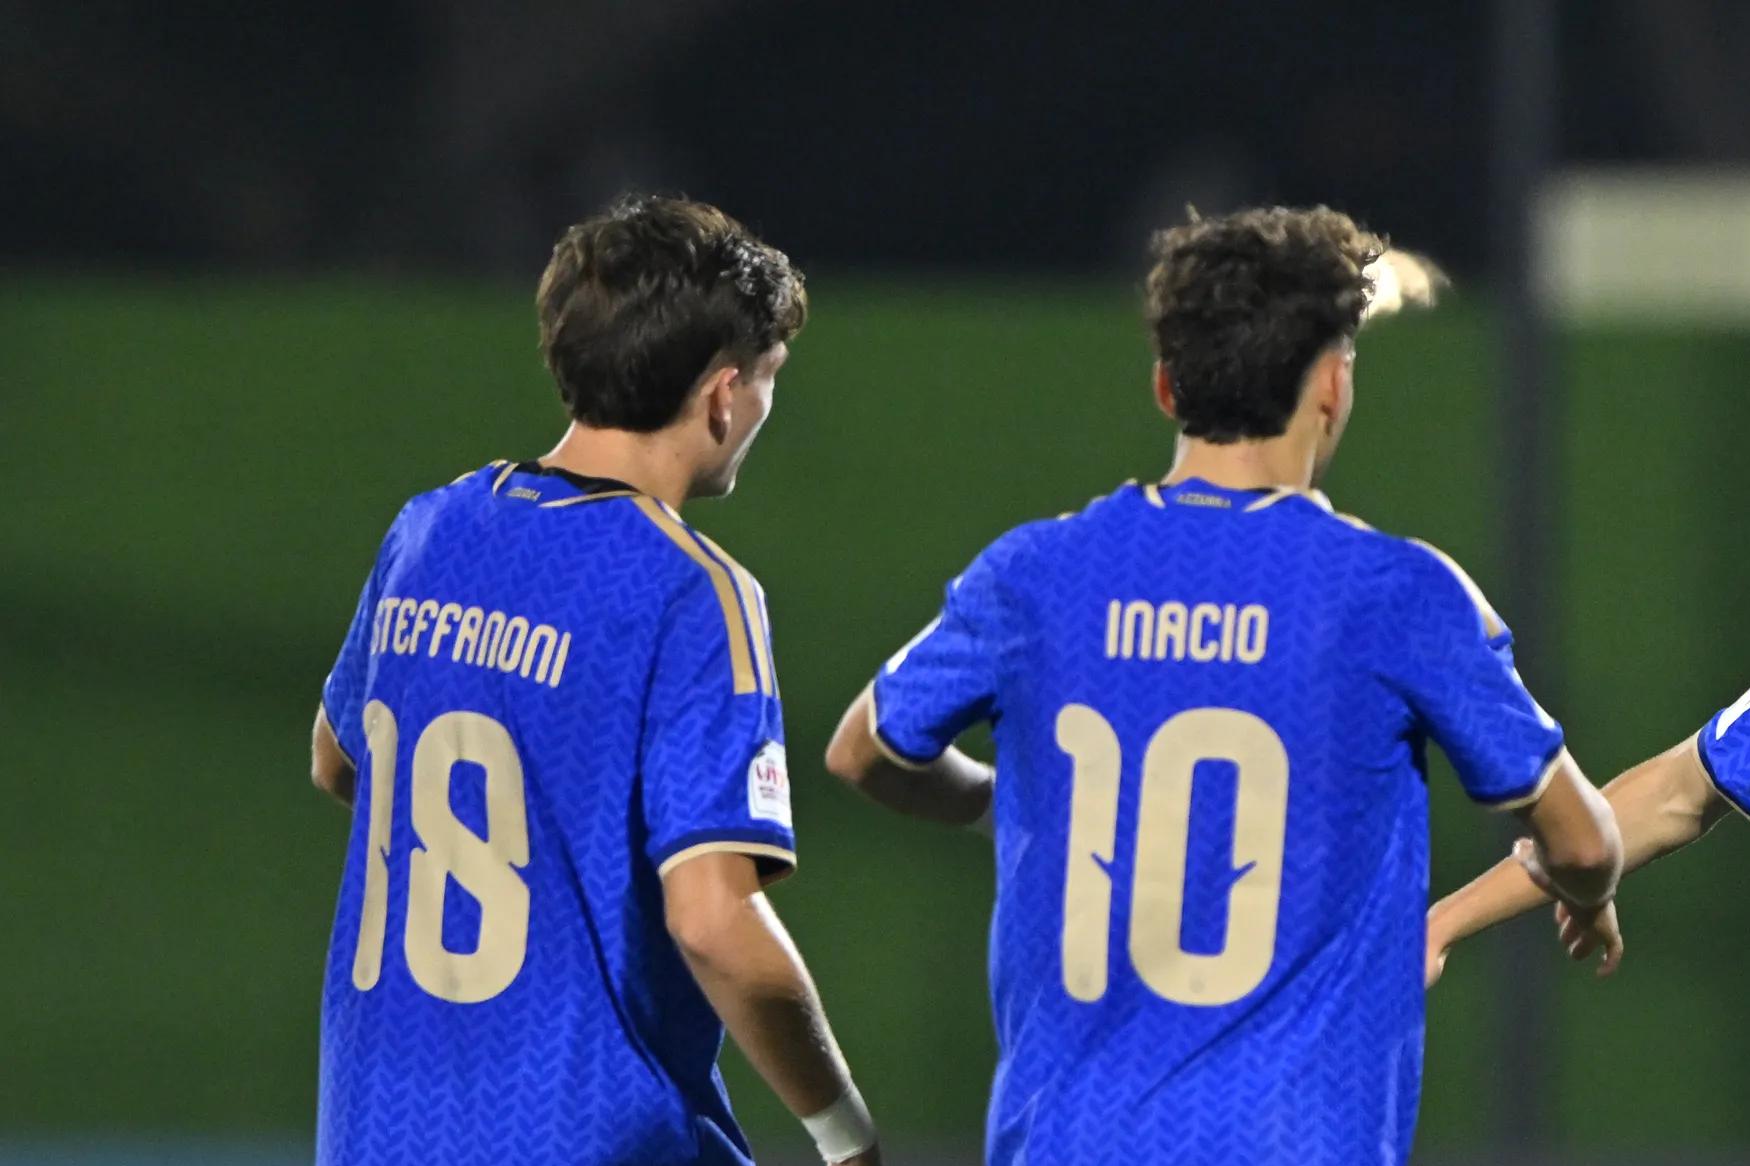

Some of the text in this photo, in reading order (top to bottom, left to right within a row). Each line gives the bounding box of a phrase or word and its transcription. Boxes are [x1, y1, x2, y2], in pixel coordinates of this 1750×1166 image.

[1105, 599, 1269, 664] INACIO
[352, 699, 530, 1003] 18
[1055, 703, 1289, 1006] 10
